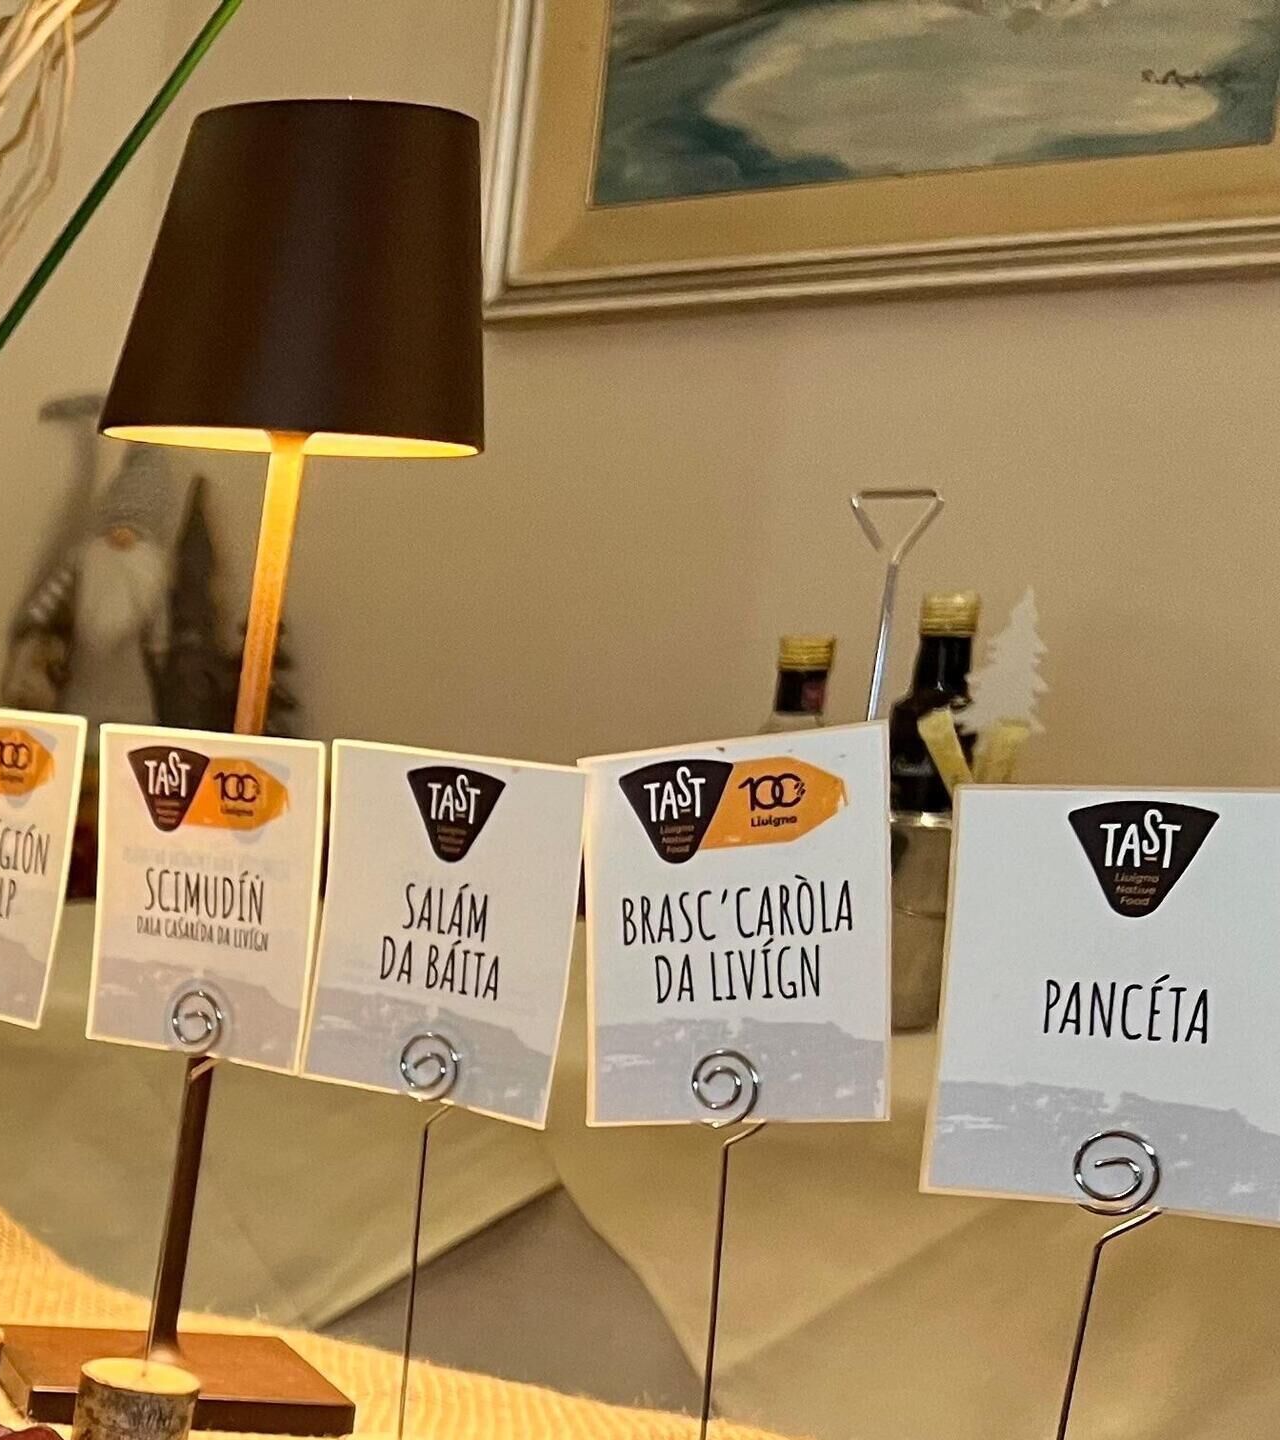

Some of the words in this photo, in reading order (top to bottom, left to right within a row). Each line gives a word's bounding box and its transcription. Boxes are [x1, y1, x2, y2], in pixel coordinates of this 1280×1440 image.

[144, 751, 191, 797] TAST
[427, 774, 481, 824] TAST
[643, 766, 707, 822] TAST
[1099, 808, 1182, 868] TAST
[402, 883, 488, 943] SALÁM
[380, 935, 412, 985] DA
[425, 939, 499, 1001] BÁITA
[655, 953, 694, 1004] DA
[710, 937, 820, 1001] LIVÍGN
[1042, 974, 1211, 1045] PANCÉTA
